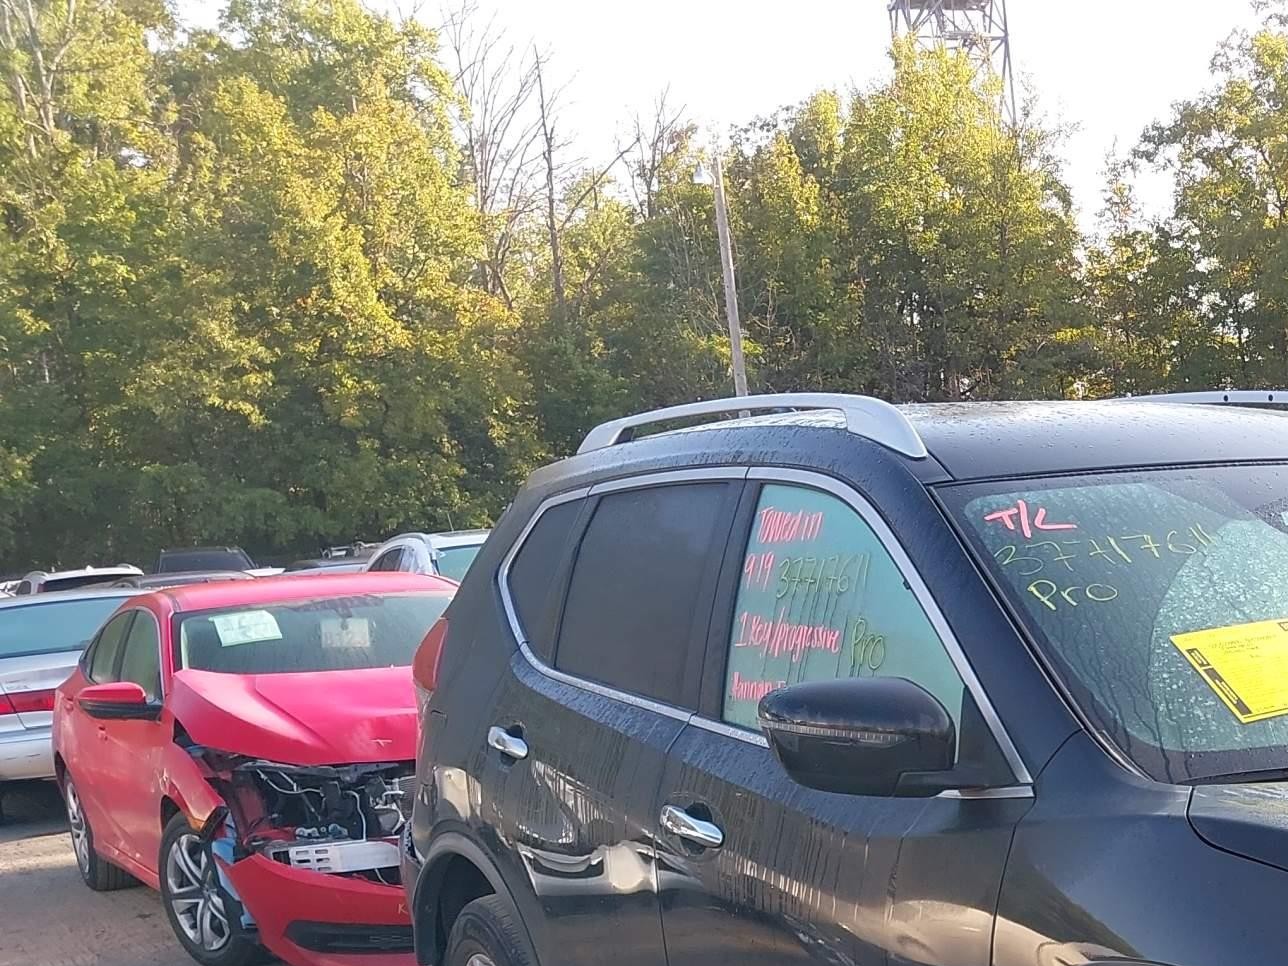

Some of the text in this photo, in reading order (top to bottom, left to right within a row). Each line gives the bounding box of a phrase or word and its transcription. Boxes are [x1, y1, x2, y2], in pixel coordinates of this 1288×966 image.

[984, 500, 1078, 538] T/L
[993, 522, 1217, 576] 37717611
[775, 551, 870, 600] 37717611
[1027, 579, 1118, 611] Pro
